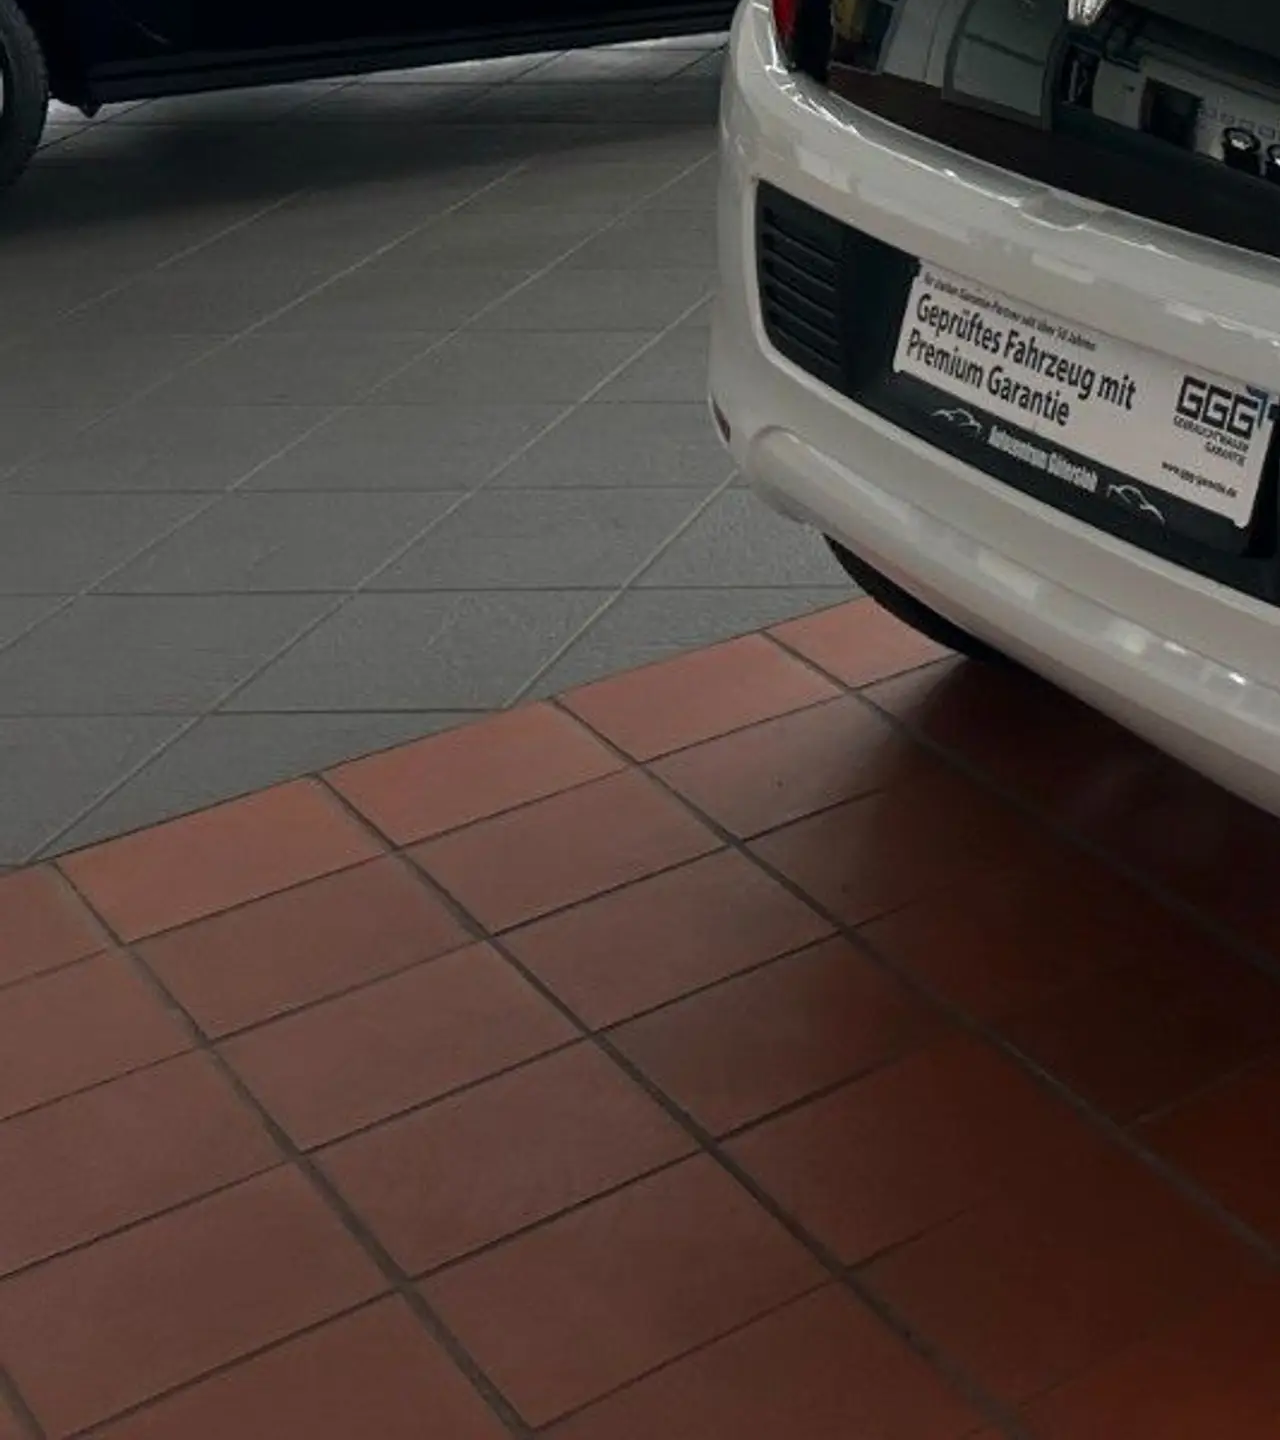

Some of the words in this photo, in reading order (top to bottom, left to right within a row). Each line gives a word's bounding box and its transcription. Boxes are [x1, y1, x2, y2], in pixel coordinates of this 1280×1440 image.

[906, 327, 985, 389] Premium
[987, 365, 1070, 427] Garantie
[916, 292, 1002, 355] Geprüftes
[1003, 328, 1096, 401] Fahrzeug
[1097, 373, 1137, 411] mit
[1176, 374, 1259, 441] GGG
